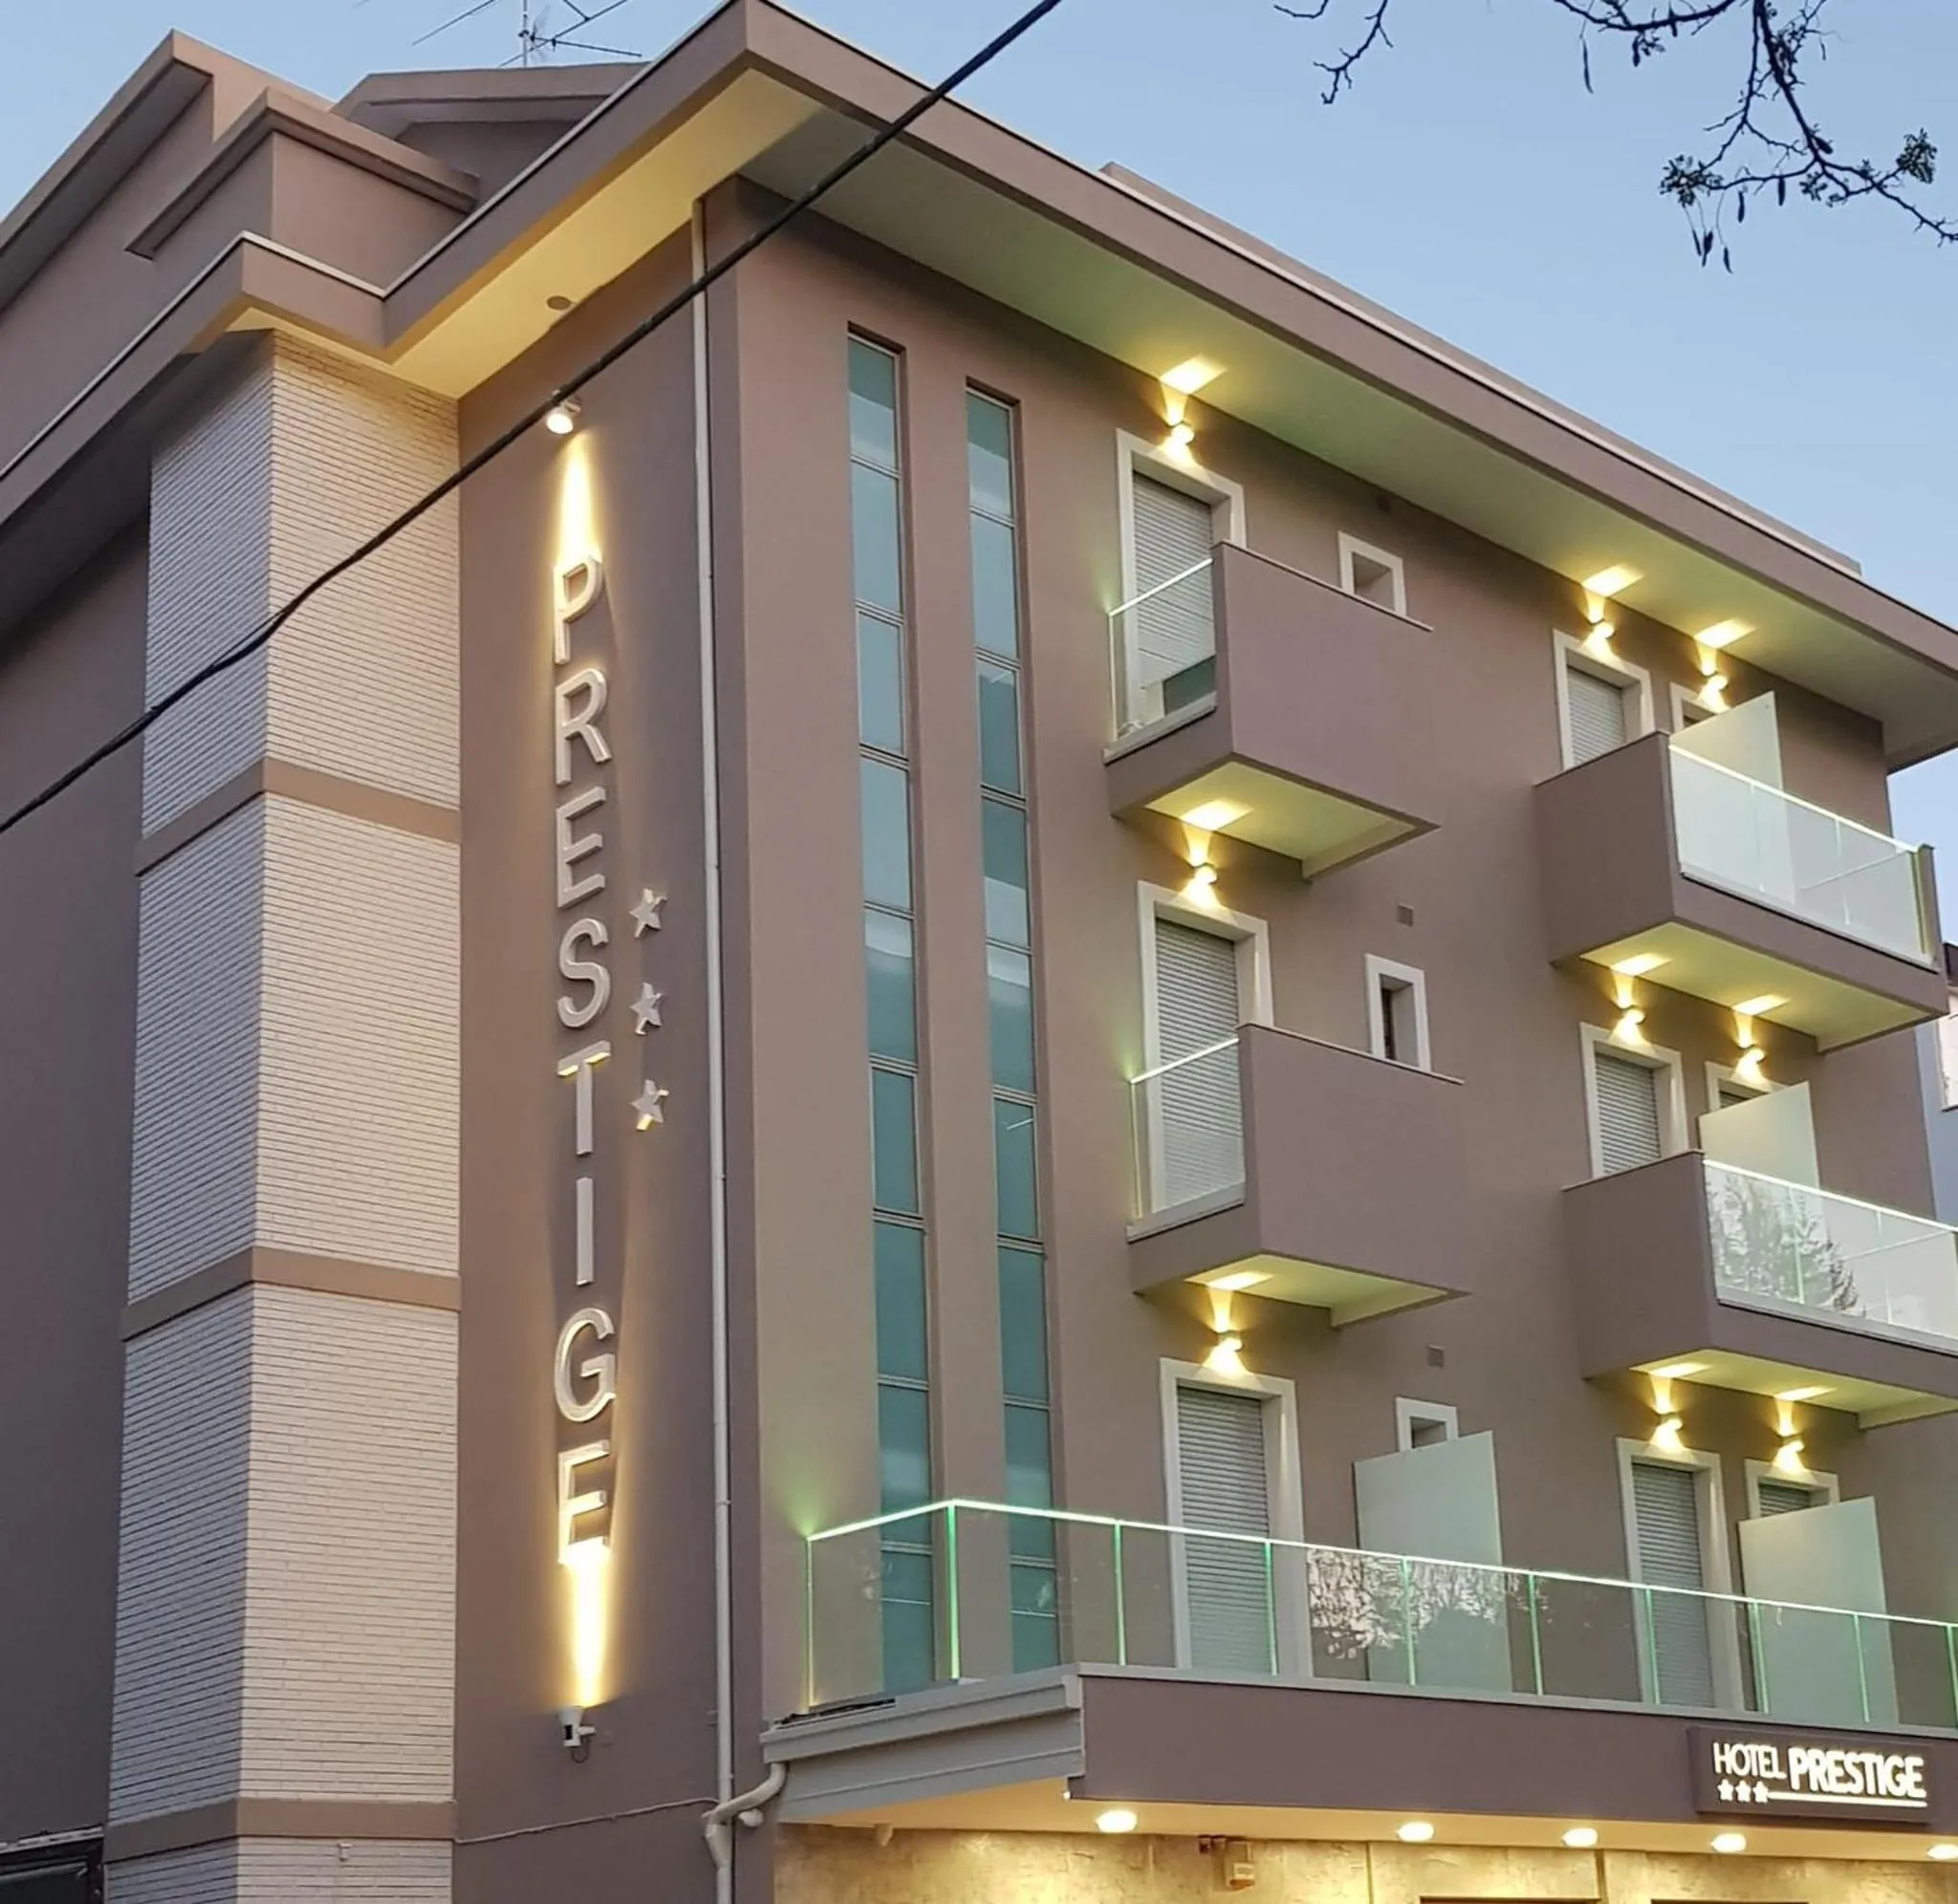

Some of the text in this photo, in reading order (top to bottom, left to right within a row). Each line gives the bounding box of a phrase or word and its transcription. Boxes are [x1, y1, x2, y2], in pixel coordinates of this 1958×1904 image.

[553, 554, 616, 1564] PRESTIGE
[1713, 1742, 1926, 1798] HOTEL PRESTIGE
